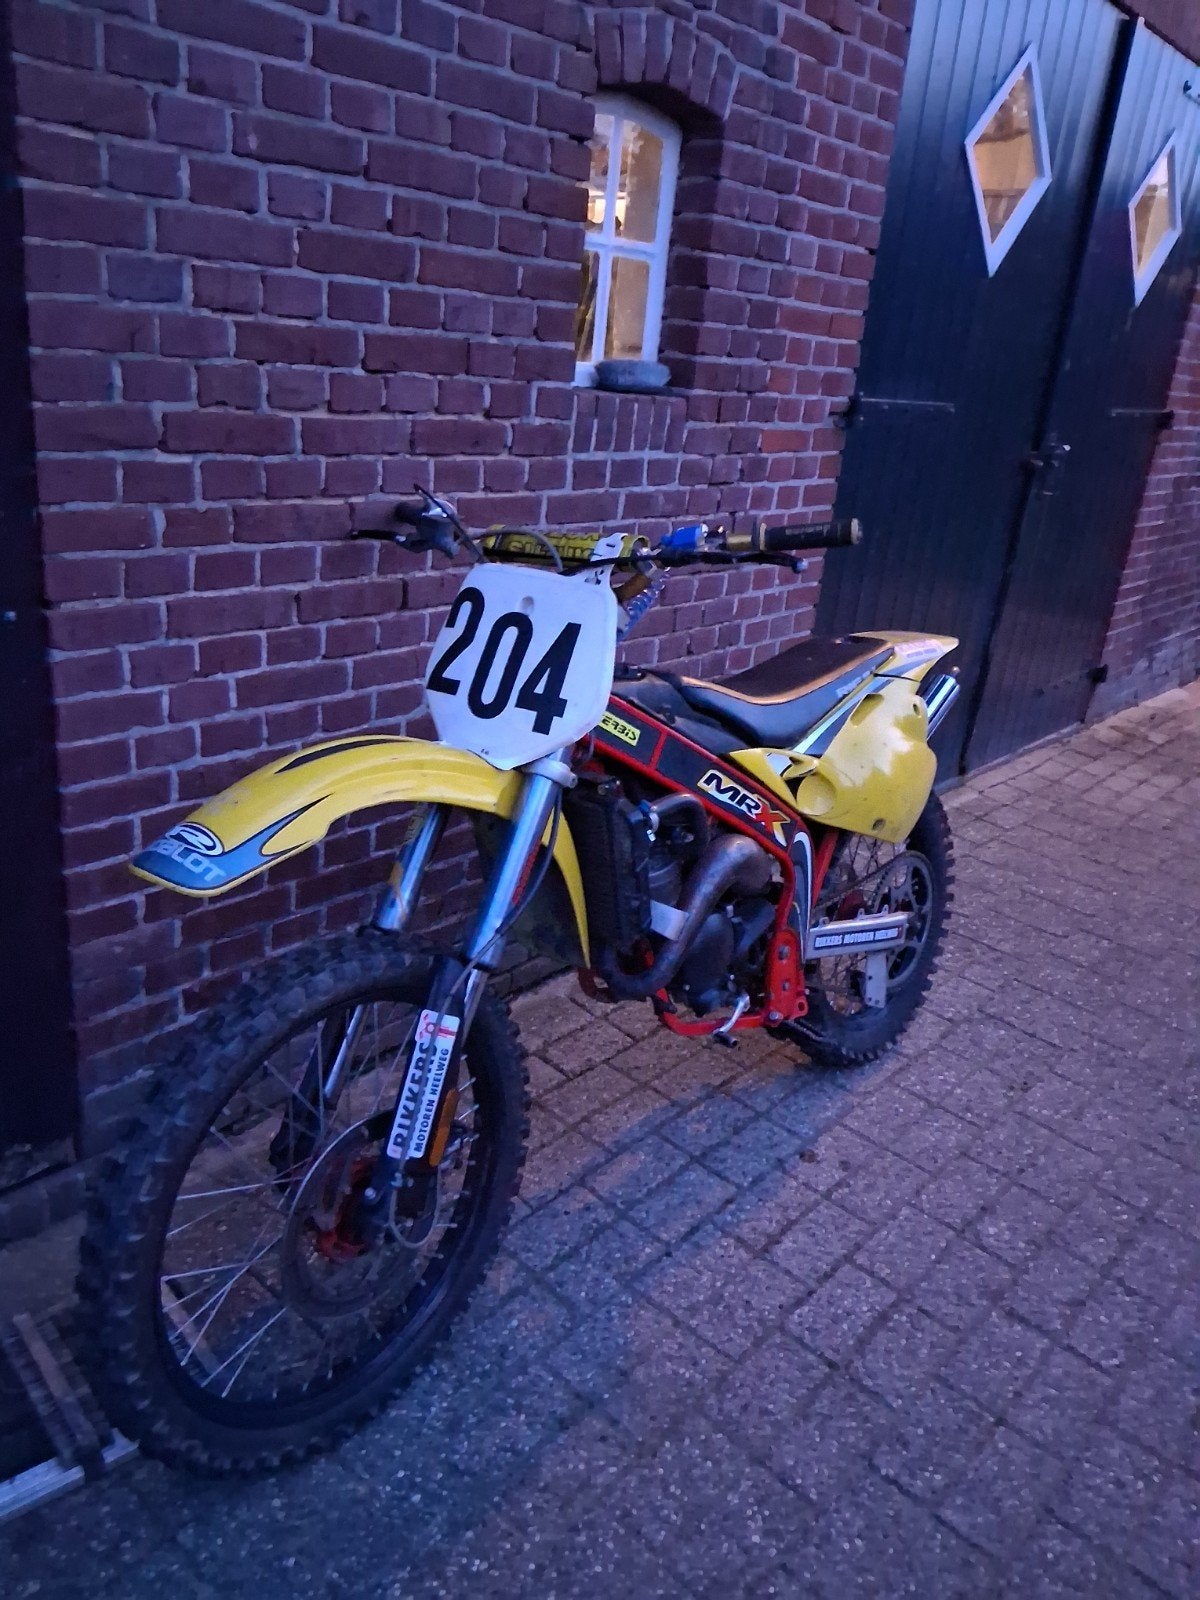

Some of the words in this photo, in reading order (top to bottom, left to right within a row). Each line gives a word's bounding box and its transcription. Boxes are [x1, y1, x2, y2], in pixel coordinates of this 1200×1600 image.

[426, 586, 582, 736] 204
[703, 771, 791, 847] MRX
[413, 1099, 436, 1153] MOTOREN
[430, 1048, 450, 1096] HEELWEG
